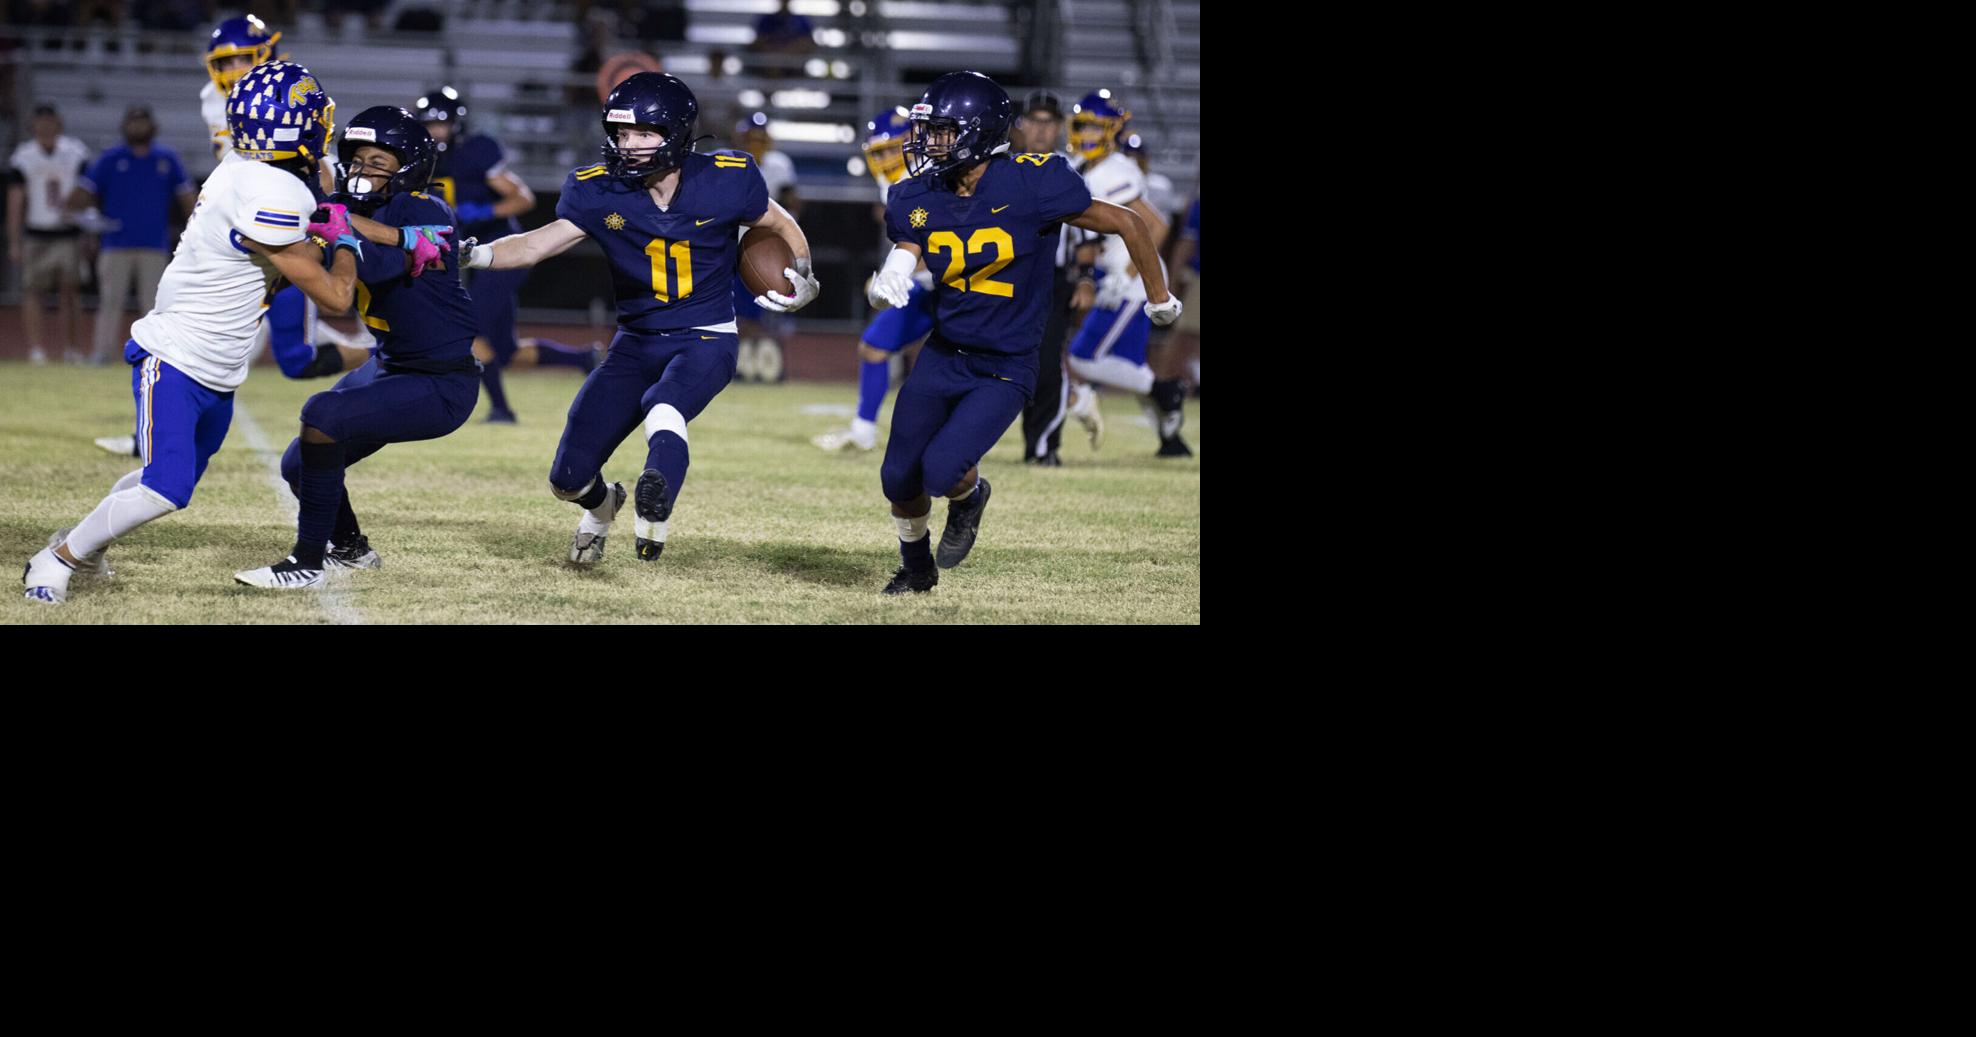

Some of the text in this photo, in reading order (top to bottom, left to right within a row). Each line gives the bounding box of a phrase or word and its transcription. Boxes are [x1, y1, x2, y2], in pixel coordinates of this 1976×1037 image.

[608, 112, 632, 120] Riddell
[714, 154, 747, 169] 11
[644, 237, 693, 303] 11
[927, 226, 1015, 298] 22
